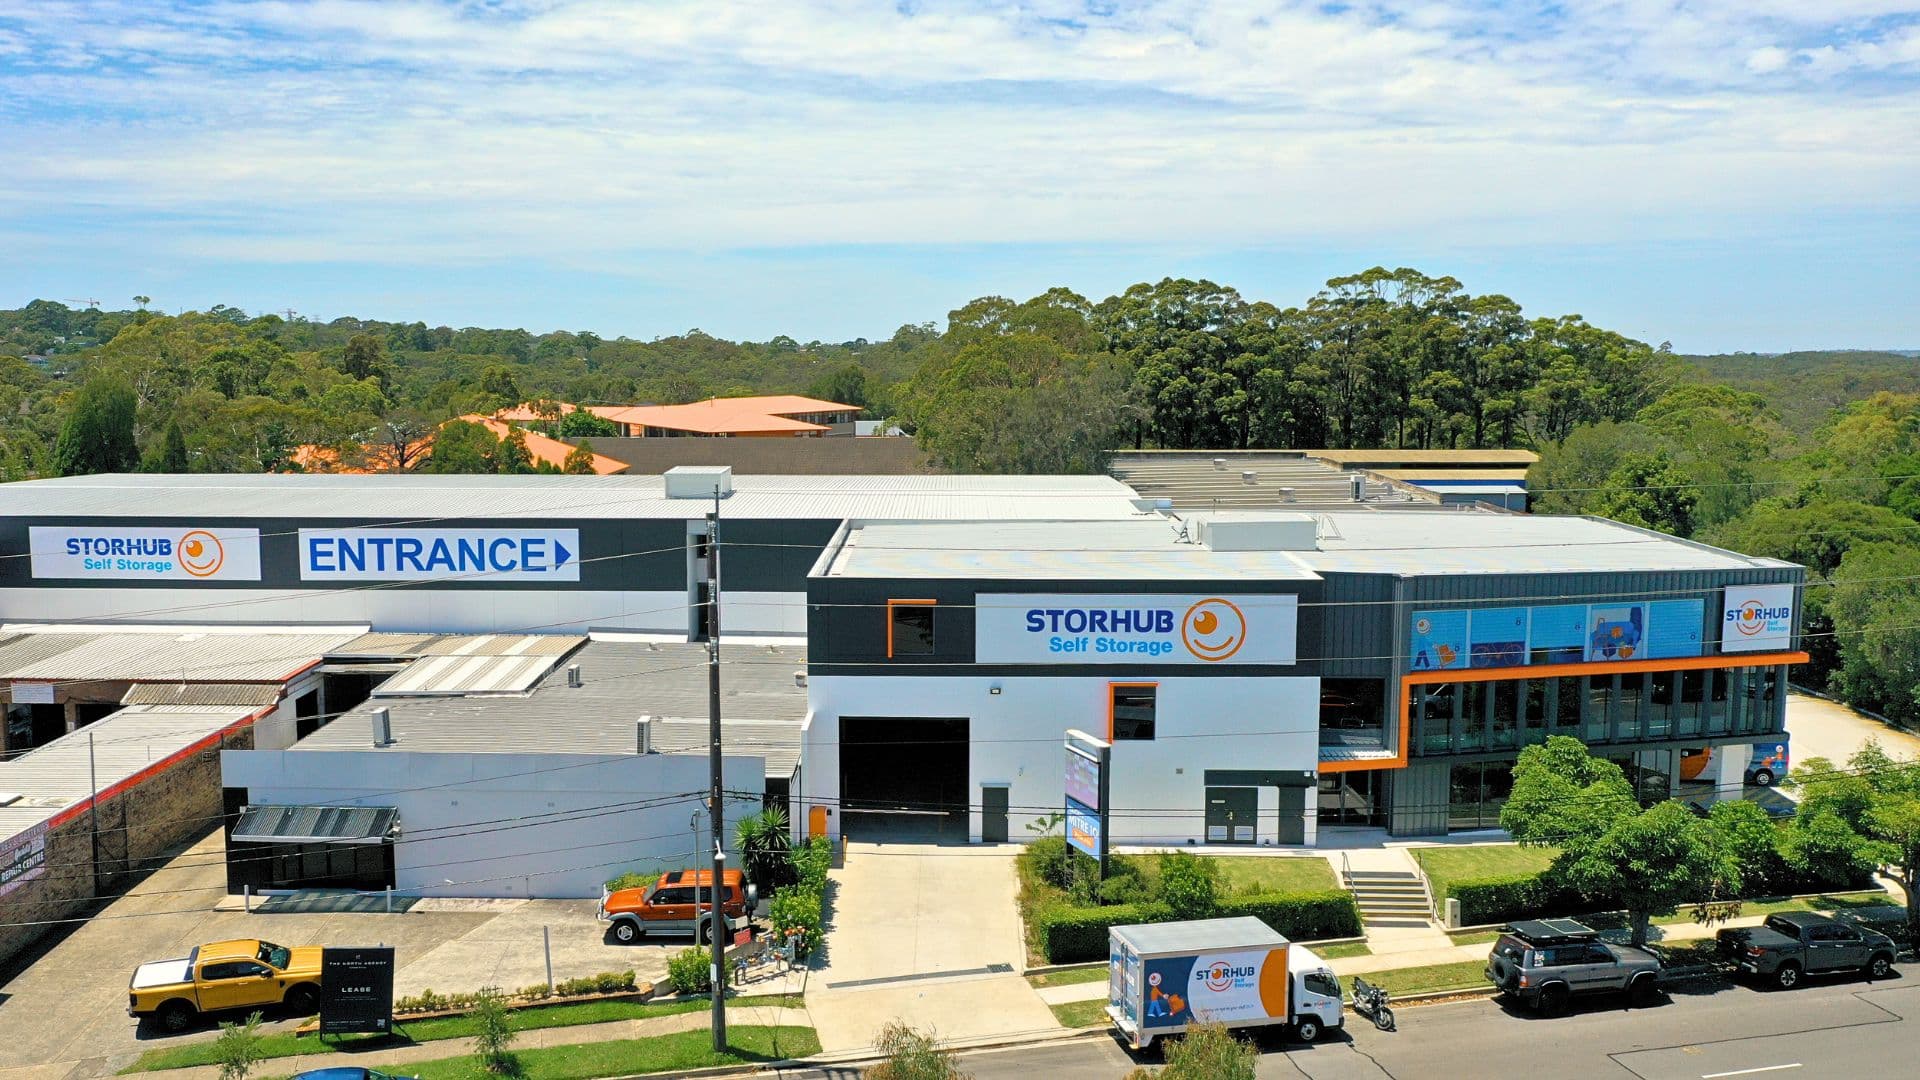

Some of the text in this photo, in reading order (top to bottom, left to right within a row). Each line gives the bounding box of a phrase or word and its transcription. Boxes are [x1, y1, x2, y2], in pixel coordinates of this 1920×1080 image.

[66, 537, 173, 556] STORHUB
[309, 537, 547, 572] ENTRANCE
[84, 557, 173, 573] Self Storage
[1025, 608, 1175, 634] STORHUB
[1048, 635, 1174, 657] Self Storage
[1069, 815, 1089, 834] MITRE
[1, 863, 22, 883] REPAIR
[22, 851, 45, 870] CENTRE
